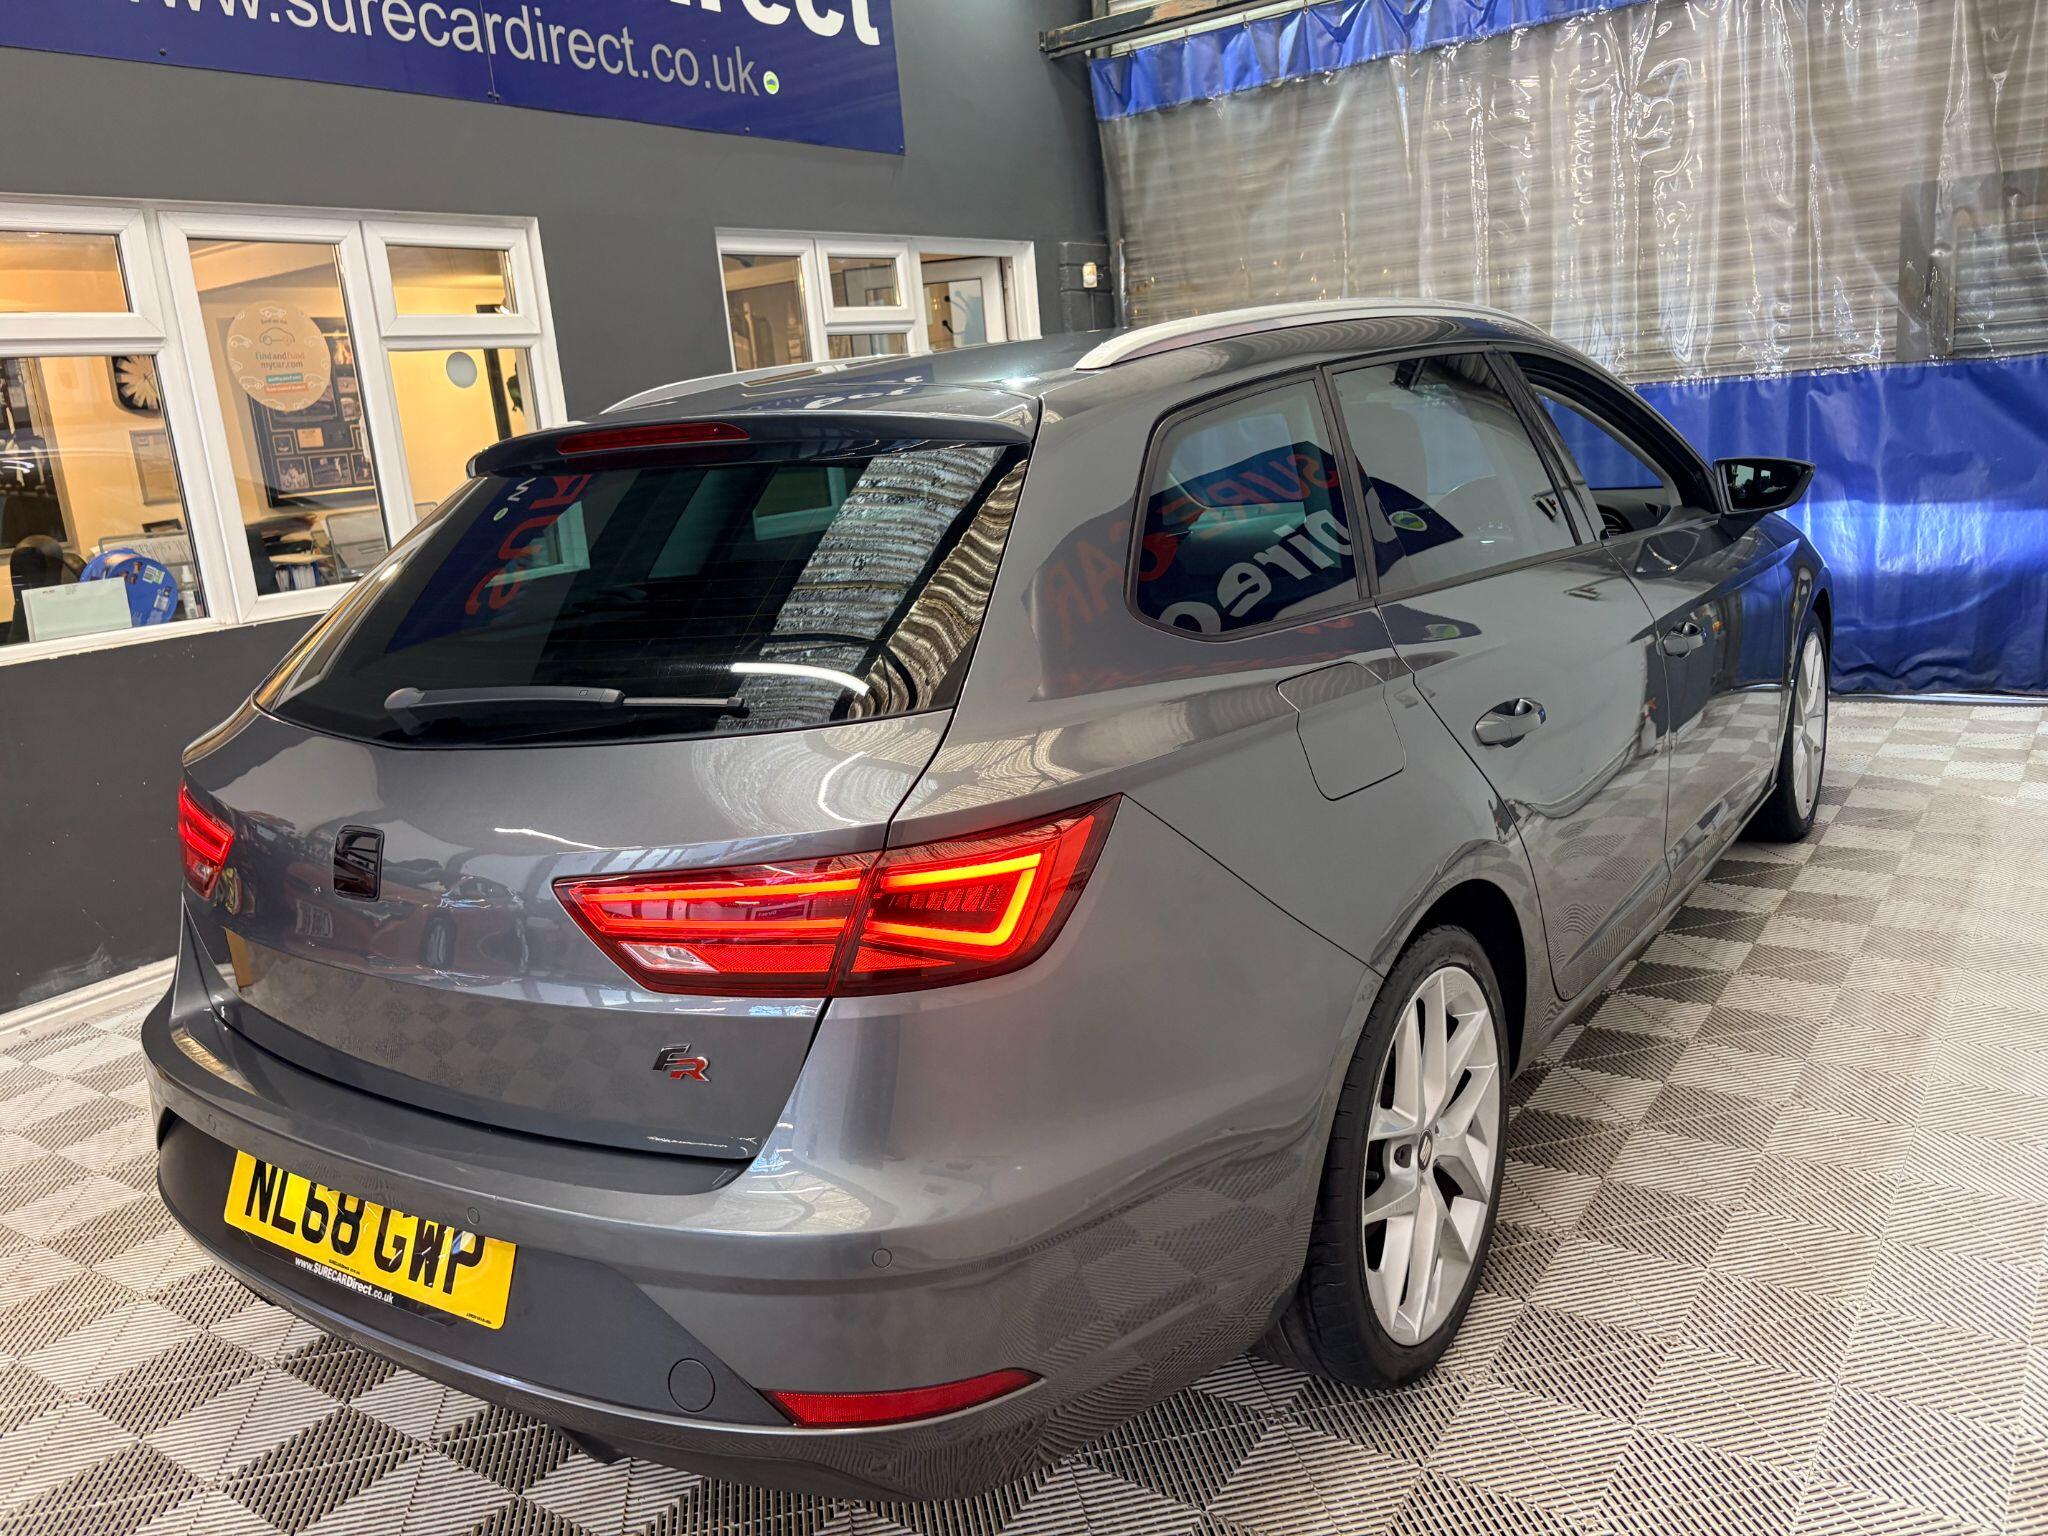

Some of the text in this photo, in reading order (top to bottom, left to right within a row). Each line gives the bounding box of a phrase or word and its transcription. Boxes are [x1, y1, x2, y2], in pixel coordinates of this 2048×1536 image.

[128, 0, 760, 96] w.surecardirect.co.uk
[652, 1042, 711, 1082] FR
[245, 1158, 486, 1295] NL68 GWP
[294, 1256, 395, 1305] www.SURECARDirect.co.uk
